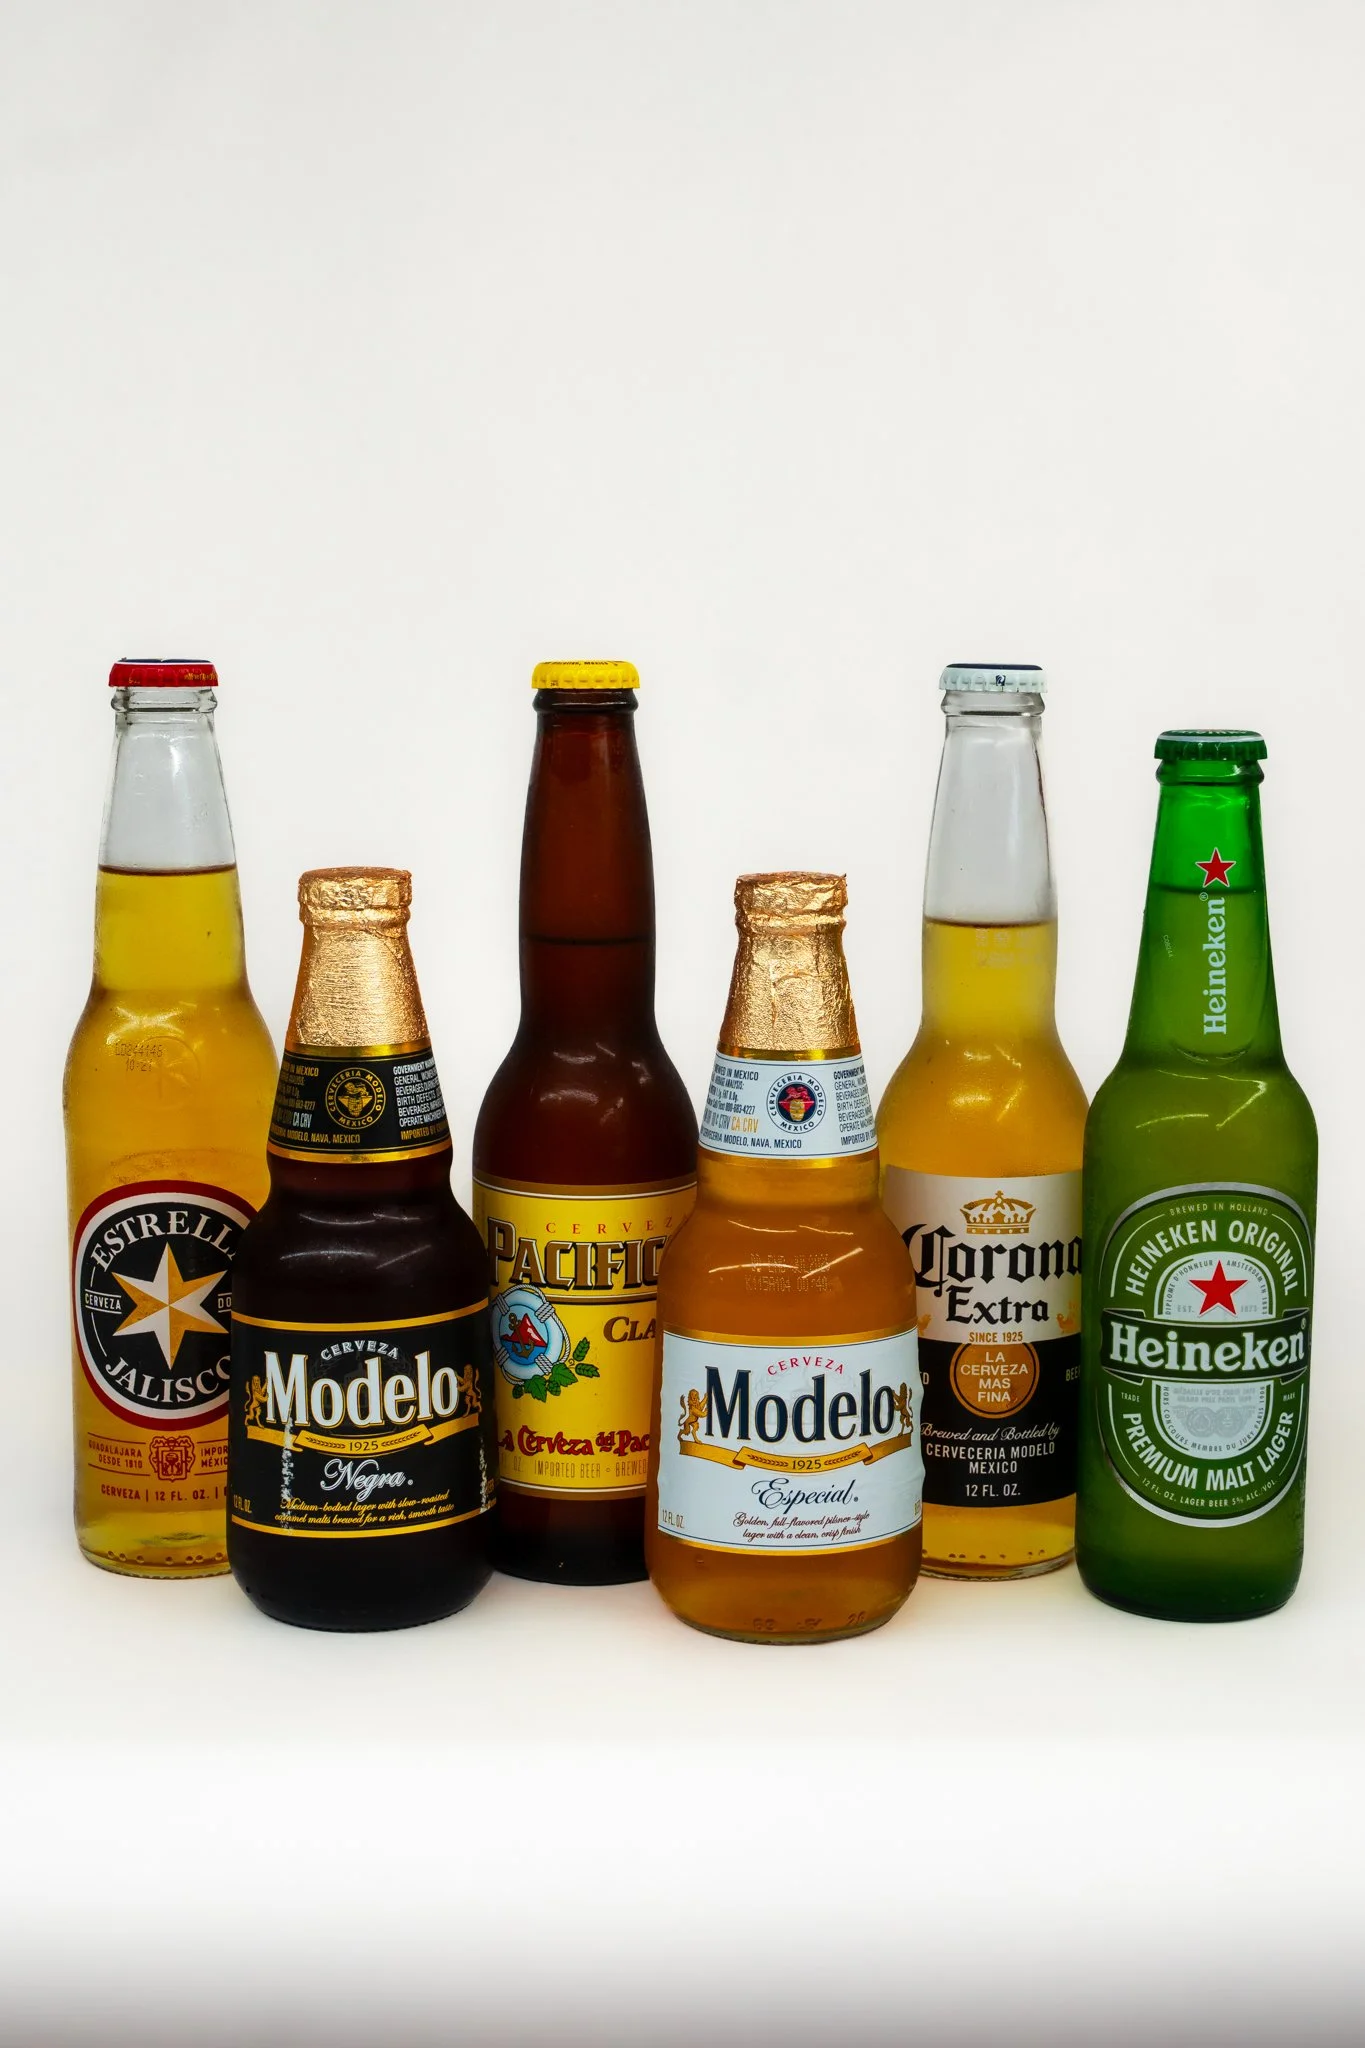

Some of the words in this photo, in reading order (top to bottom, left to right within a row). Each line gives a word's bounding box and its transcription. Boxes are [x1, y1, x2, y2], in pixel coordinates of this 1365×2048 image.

[1203, 898, 1226, 1035] Heineken
[296, 1064, 319, 1077] MEXICO
[393, 1061, 425, 1076] GOVERNMENT
[727, 1067, 732, 1077] IN
[734, 1069, 759, 1081] MEXICO
[833, 1067, 860, 1080] GOVERNMENT
[394, 1073, 421, 1086] GENERAL,
[328, 1070, 361, 1112] CERVECERIA
[365, 1073, 382, 1111] MODELO
[396, 1083, 424, 1096] BEVERAGES
[769, 1075, 803, 1117] CERVECERIA
[807, 1079, 823, 1117] MODELO
[836, 1090, 860, 1101] BEVERAGES
[397, 1095, 415, 1107] BIRTH
[837, 1101, 853, 1112] BIRTH
[398, 1103, 430, 1117] BEVERAGES
[838, 1109, 865, 1122] BEVERAGES
[293, 1112, 300, 1127] CA
[300, 1113, 312, 1129] CRV
[338, 1116, 374, 1127] MEXICO
[399, 1115, 423, 1128] OPERATE
[731, 1116, 740, 1131] CA
[742, 1117, 759, 1133] CRV
[780, 1121, 815, 1132] MEXICO
[839, 1121, 860, 1133] OPERATE
[311, 1133, 331, 1145] NAVA,
[333, 1134, 361, 1144] MEXICO
[401, 1128, 430, 1140] IMPORTED
[724, 1133, 749, 1147] MODELO,
[751, 1138, 771, 1149] NAVA,
[774, 1139, 802, 1149] MEXICO
[841, 1134, 865, 1146] IMPORTED
[1169, 1203, 1208, 1216] BREWED
[1213, 1203, 1224, 1211] IN
[1230, 1203, 1268, 1216] HOLLAND
[90, 1210, 236, 1272] ESTRELL
[901, 1223, 1082, 1298] Corona
[1125, 1219, 1217, 1296] HEINEKEN
[1228, 1220, 1299, 1296] ORIGINAL
[1165, 1283, 1176, 1316] DIPLOME
[1173, 1260, 1213, 1282] D'HONNEUR
[1226, 1260, 1263, 1283] AMSTERDAM
[84, 1292, 122, 1310] CERVEZA
[946, 1284, 1050, 1325] Extra
[1177, 1304, 1195, 1313] EST.
[968, 1332, 998, 1343] SINCE
[1002, 1331, 1023, 1342] 1925
[320, 1339, 399, 1361] CERVEZA
[1110, 1321, 1305, 1372] Heineken
[985, 1351, 1005, 1363] LA
[767, 1356, 845, 1376] CERVEZA
[960, 1363, 1029, 1376] CERVEZA
[264, 1350, 460, 1429] Modelo
[979, 1378, 1011, 1389] MAS
[705, 1366, 896, 1443] Modelo
[977, 1391, 1012, 1403] FINA
[1121, 1391, 1140, 1403] TRADE
[920, 1422, 970, 1441] Brewed
[971, 1428, 1001, 1441] and
[1000, 1423, 1048, 1441] Bottled
[1047, 1421, 1060, 1441] by
[1164, 1409, 1188, 1445] CONCOURS
[1190, 1443, 1223, 1452] MEMBRE
[1226, 1443, 1236, 1451] DU
[1239, 1431, 1255, 1446] JURY
[1254, 1407, 1264, 1430] PARIS
[88, 1439, 143, 1458] GUADALAJARA
[349, 1441, 379, 1451] 1925
[517, 1425, 595, 1457] Cerveza
[595, 1431, 616, 1452] del
[926, 1443, 1006, 1460] CERVECERIA
[1010, 1442, 1055, 1459] MODELO
[1123, 1412, 1199, 1490] PREMIUM
[1205, 1460, 1256, 1491] MALT
[1256, 1411, 1294, 1473] LAGER
[98, 1454, 121, 1467] DESDE
[534, 1459, 575, 1478] IMPORTED
[580, 1463, 601, 1478] BEER
[615, 1458, 647, 1477] BREWED
[791, 1459, 822, 1470] 1925
[969, 1461, 1018, 1474] MEXICO
[101, 1484, 140, 1500] CERVEZA
[155, 1491, 165, 1500] 12
[171, 1491, 187, 1501] FL.
[192, 1490, 210, 1500] OZ.
[751, 1478, 855, 1515] Especial
[965, 1484, 978, 1497] 12
[982, 1484, 999, 1497] FL.
[1003, 1484, 1021, 1497] OZ.
[1142, 1478, 1151, 1487] 12
[1151, 1484, 1161, 1495] FL.
[1163, 1491, 1177, 1502] OZ.
[1180, 1496, 1205, 1507] LAGER
[1208, 1499, 1228, 1507] BEER
[280, 1497, 351, 1512] Medium-bodied
[352, 1502, 376, 1516] lager
[378, 1499, 397, 1510] with
[398, 1489, 450, 1507] slow-roasted
[308, 1513, 331, 1524] malts
[332, 1513, 365, 1525] brewed
[358, 1513, 378, 1527] for
[388, 1510, 407, 1521] rich,
[408, 1505, 437, 1519] smooth
[662, 1510, 668, 1521] 12
[732, 1512, 769, 1528] Golden,
[769, 1515, 824, 1529] full-flavored
[823, 1510, 870, 1529] pilsner-style
[743, 1528, 765, 1543] lager
[766, 1528, 785, 1539] with
[794, 1530, 819, 1539] clean,
[821, 1530, 840, 1541] crisp
[839, 1526, 861, 1540] finish
